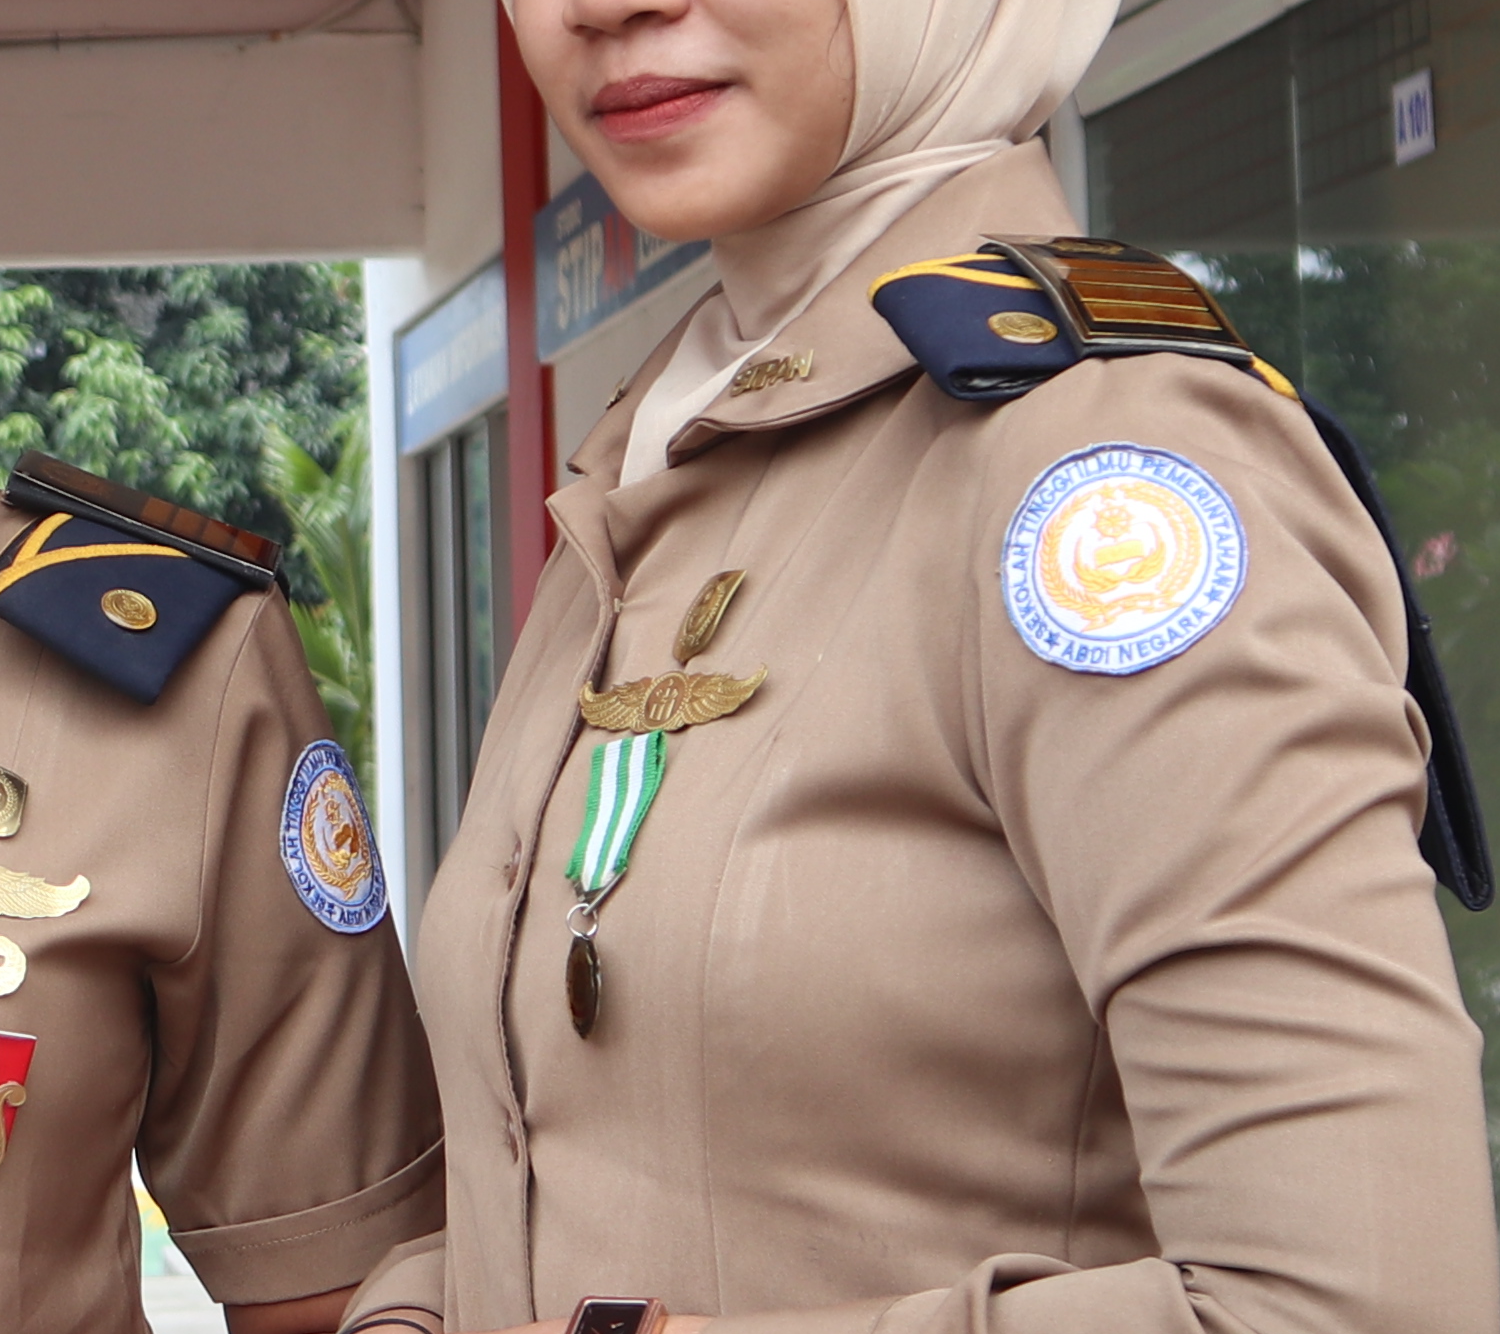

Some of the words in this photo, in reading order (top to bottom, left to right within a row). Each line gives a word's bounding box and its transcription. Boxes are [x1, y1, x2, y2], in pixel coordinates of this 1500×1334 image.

[1018, 466, 1074, 535] TINGGI
[1073, 452, 1132, 482] ILMU
[1140, 454, 1239, 593] PEMERINTAHAN
[1011, 541, 1051, 640] SEKOLAH
[1062, 637, 1110, 664] ABDI
[1118, 605, 1212, 664] NEGARA
